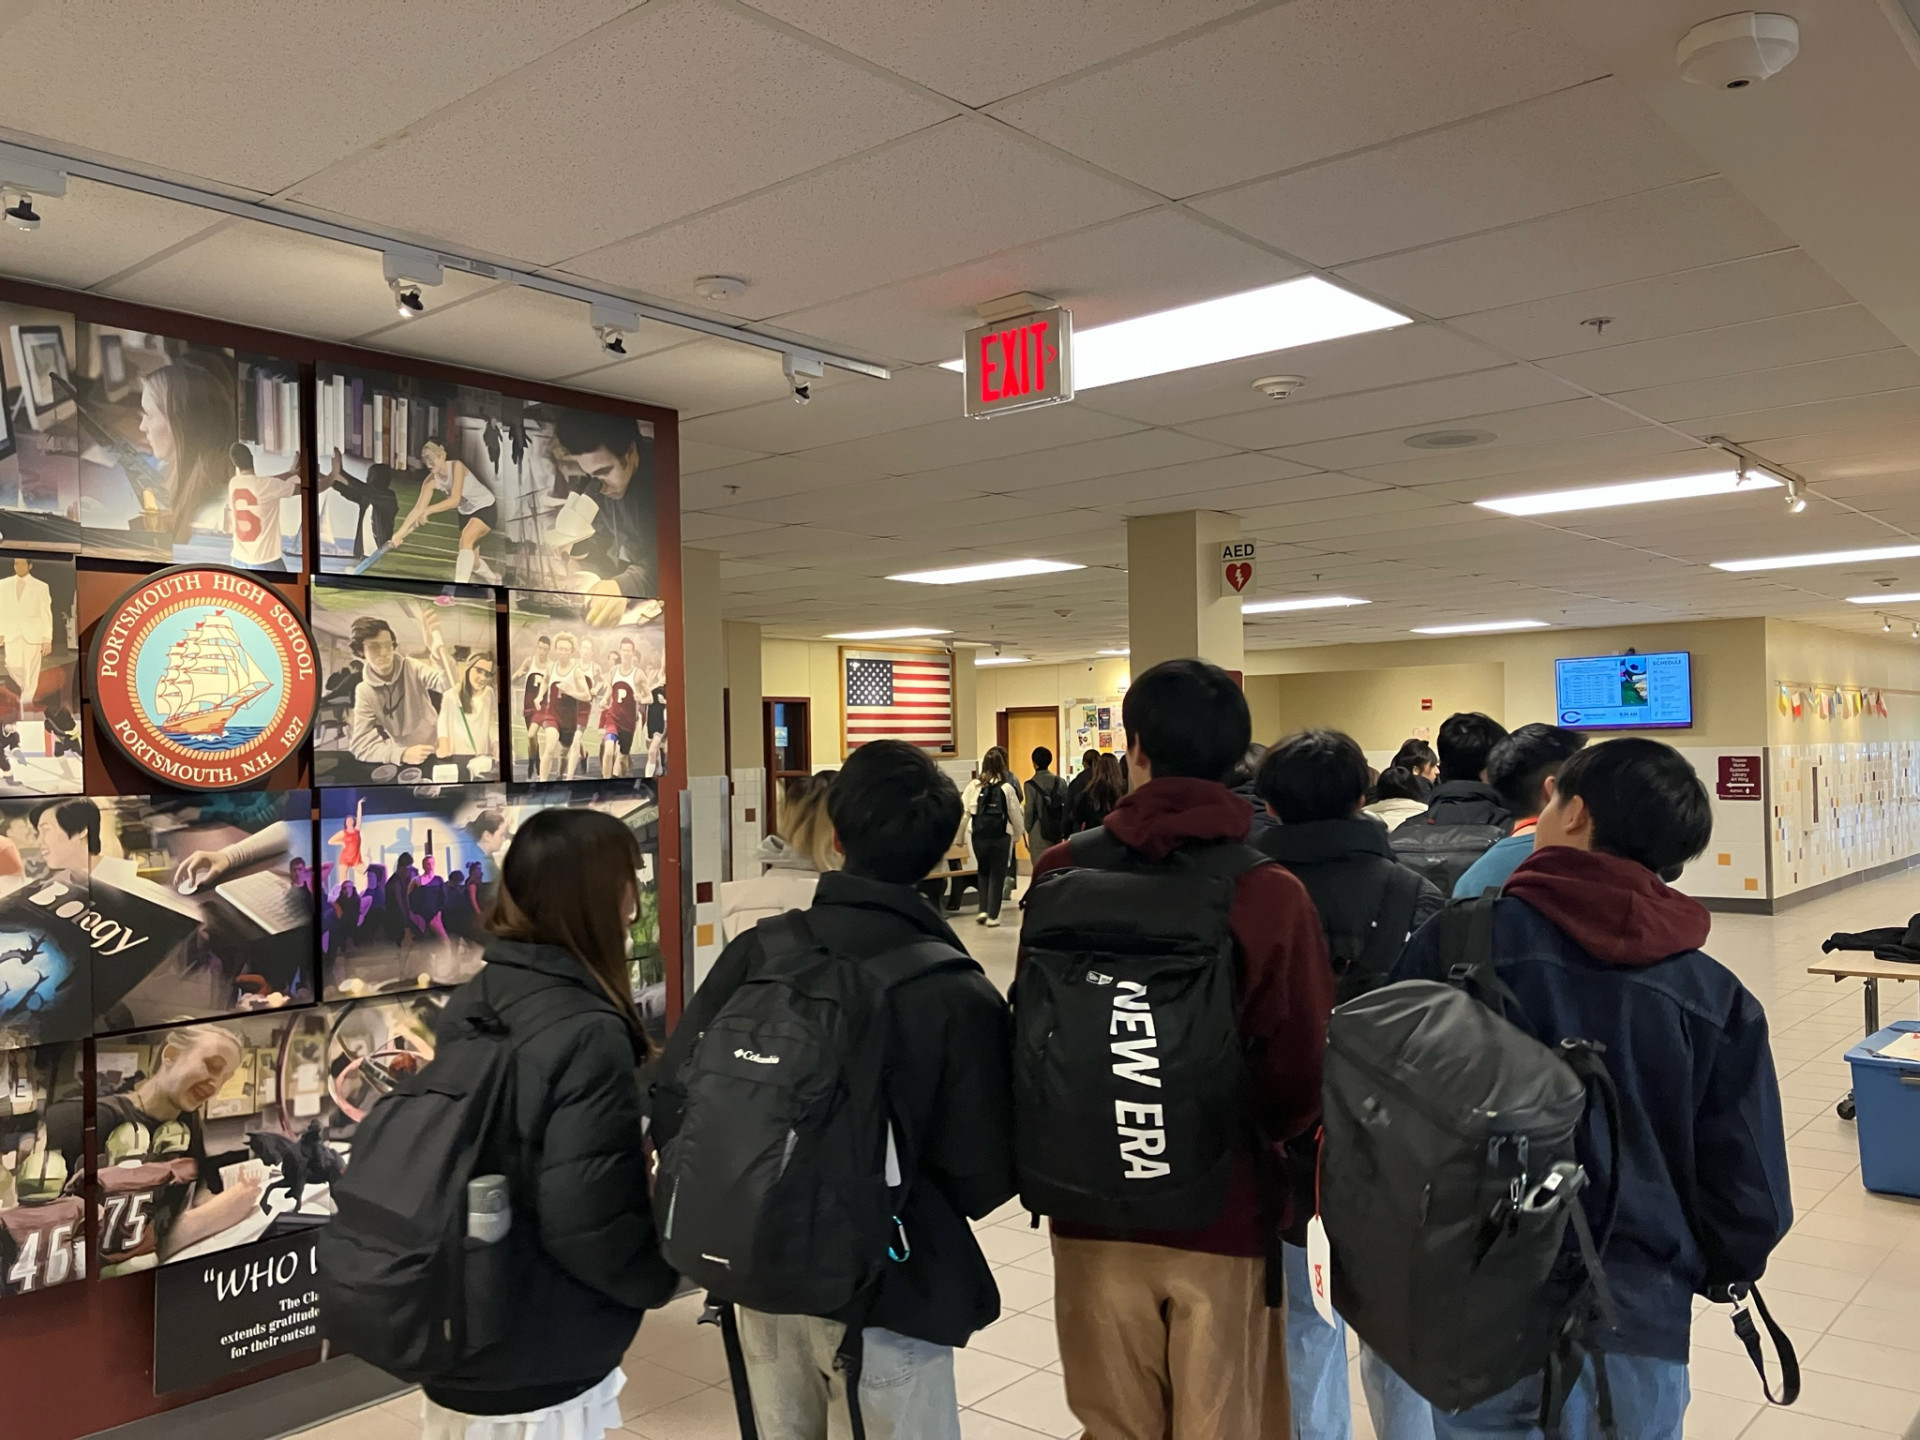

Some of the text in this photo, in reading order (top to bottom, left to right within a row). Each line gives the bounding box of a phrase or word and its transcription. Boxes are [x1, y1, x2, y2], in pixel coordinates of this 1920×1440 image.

[981, 321, 1048, 402] EXIT
[232, 488, 262, 542] 6
[1223, 544, 1255, 559] AED
[101, 573, 313, 681] PORTSMOUTH HIGH SCHOOL
[115, 715, 304, 784] PORTSMOUTH, N.H. 1827
[1109, 980, 1171, 1179] NEW ERA
[102, 1193, 153, 1250] 75
[8, 1225, 73, 1292] 46
[279, 1297, 300, 1311] The
[220, 1323, 266, 1345] extends
[231, 1345, 248, 1359] for
[250, 1336, 279, 1352] their
